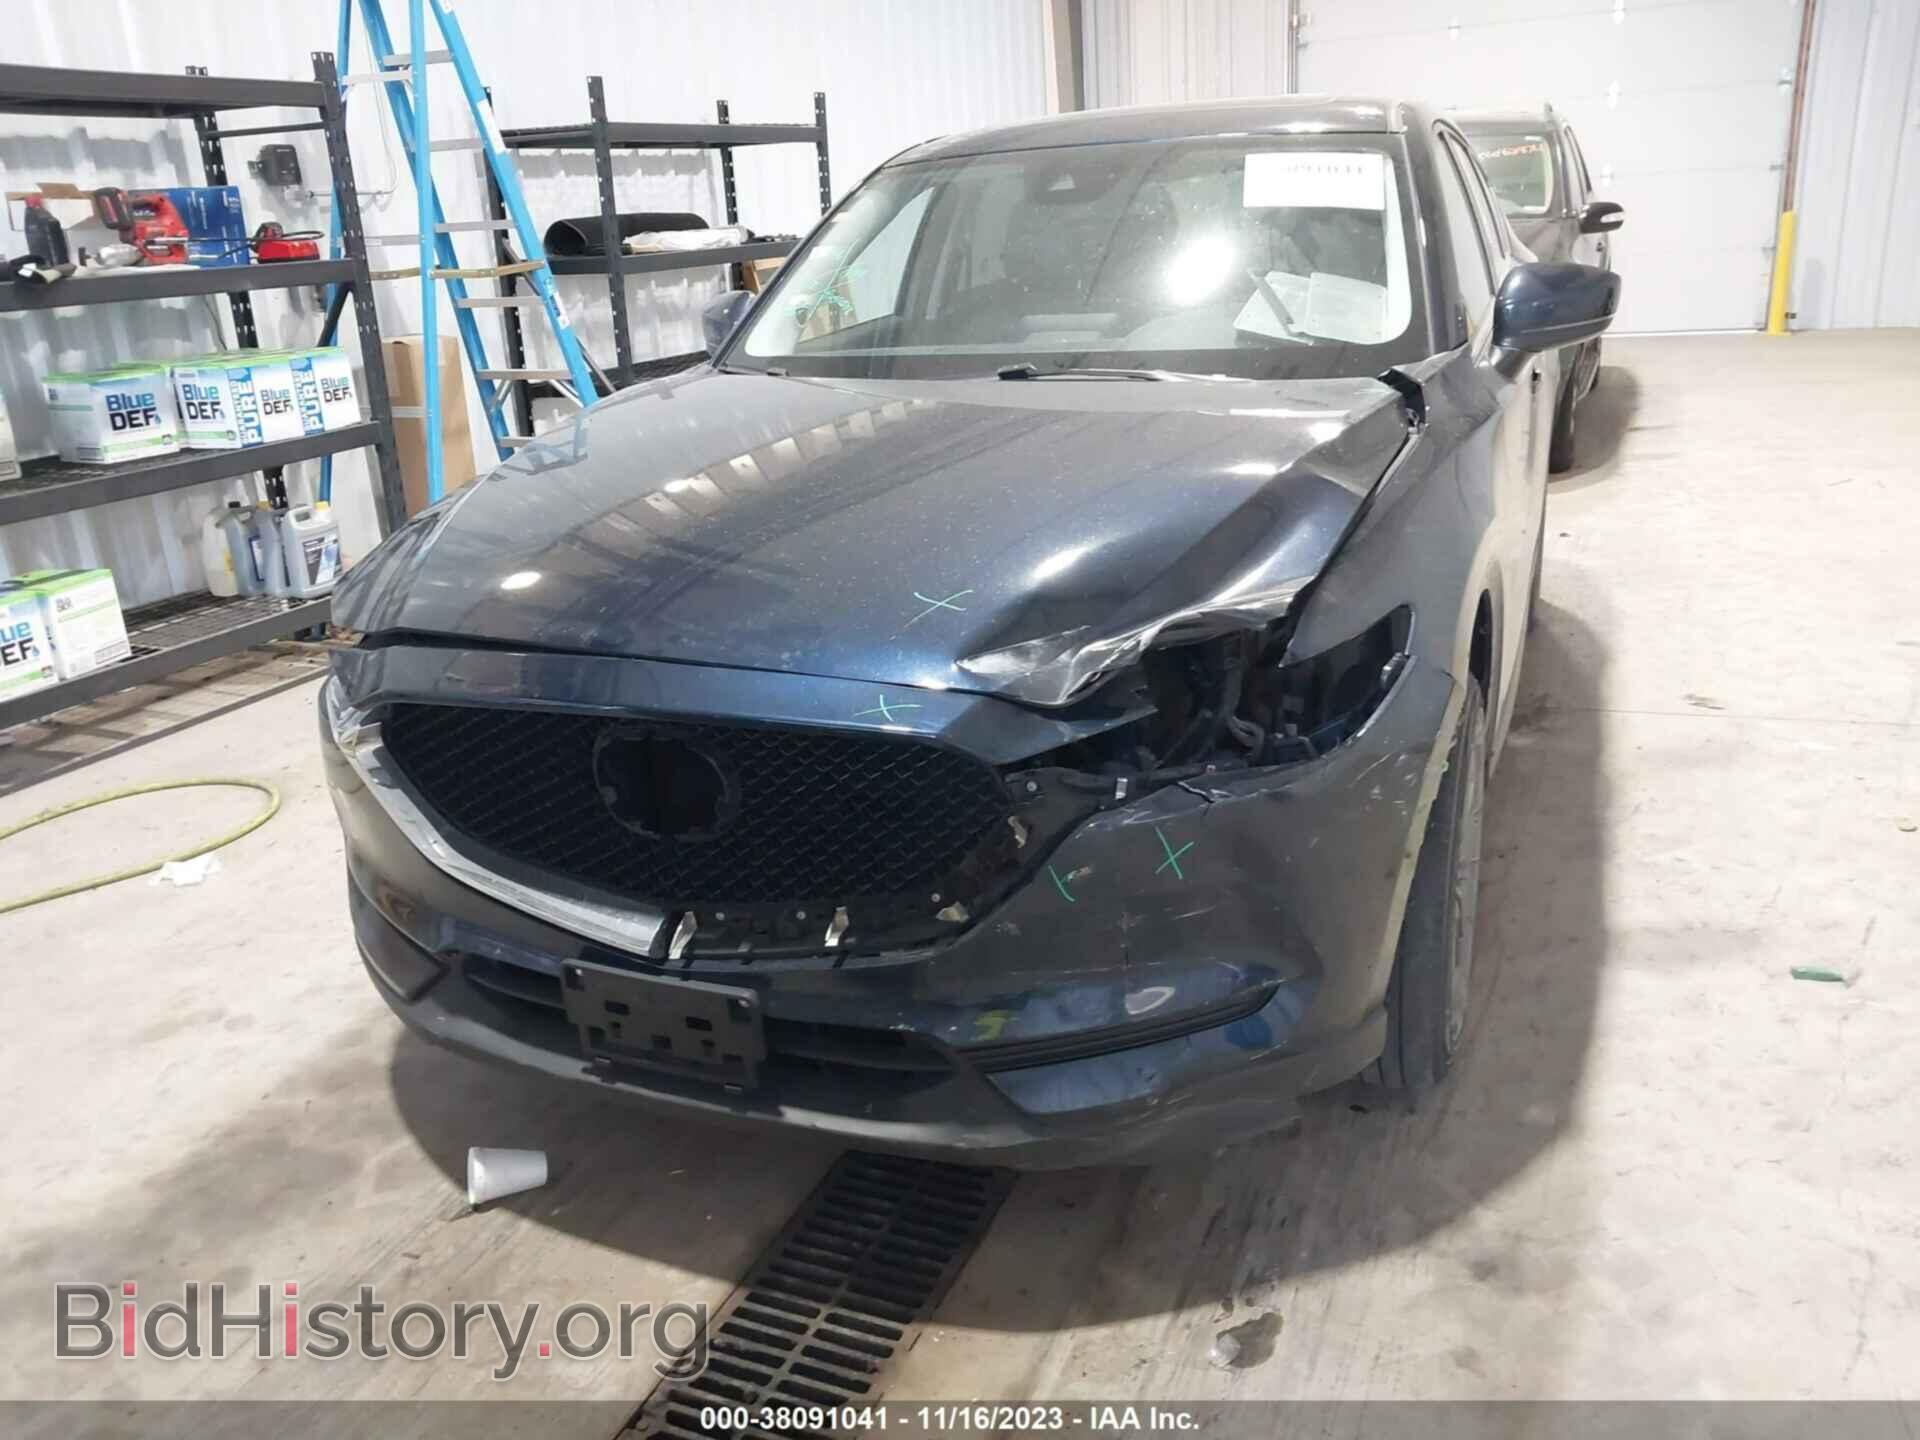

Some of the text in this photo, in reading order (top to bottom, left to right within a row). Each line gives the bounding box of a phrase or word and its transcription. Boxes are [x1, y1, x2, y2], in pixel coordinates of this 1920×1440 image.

[321, 376, 349, 390] Blue
[182, 384, 219, 401] Blue
[260, 388, 290, 401] Blue
[324, 387, 350, 402] DEF
[105, 393, 155, 411] Blue
[263, 400, 291, 415] DEF
[110, 407, 157, 431] DEF
[185, 402, 221, 420] DEF
[0, 637, 34, 665] EF
